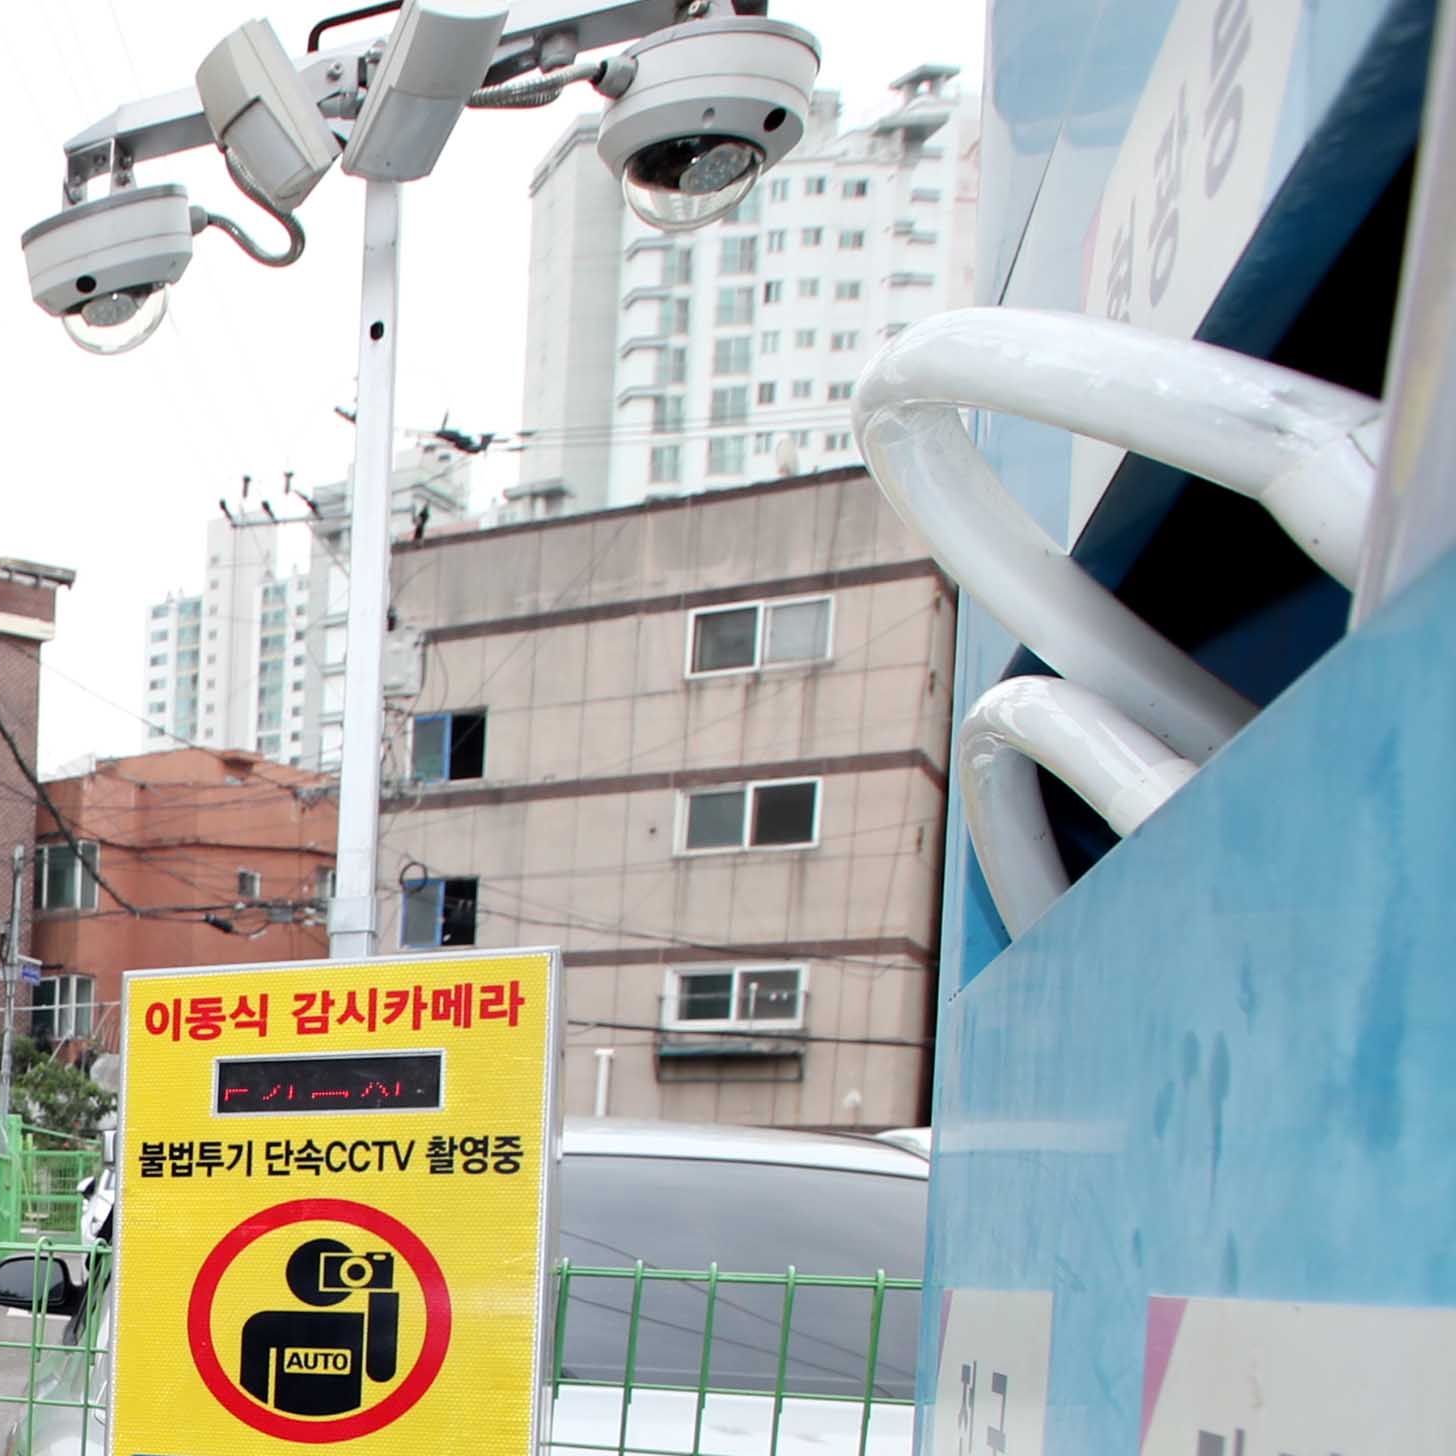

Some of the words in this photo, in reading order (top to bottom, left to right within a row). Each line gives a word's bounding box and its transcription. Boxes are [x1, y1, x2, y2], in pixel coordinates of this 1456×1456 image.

[145, 992, 269, 1042] 이동식
[291, 980, 525, 1035] 감시카메라
[139, 1140, 254, 1177] 불법투기
[265, 1139, 415, 1177] 단속CCTV
[426, 1135, 524, 1176] 촬영중
[287, 1352, 349, 1372] AUTO
